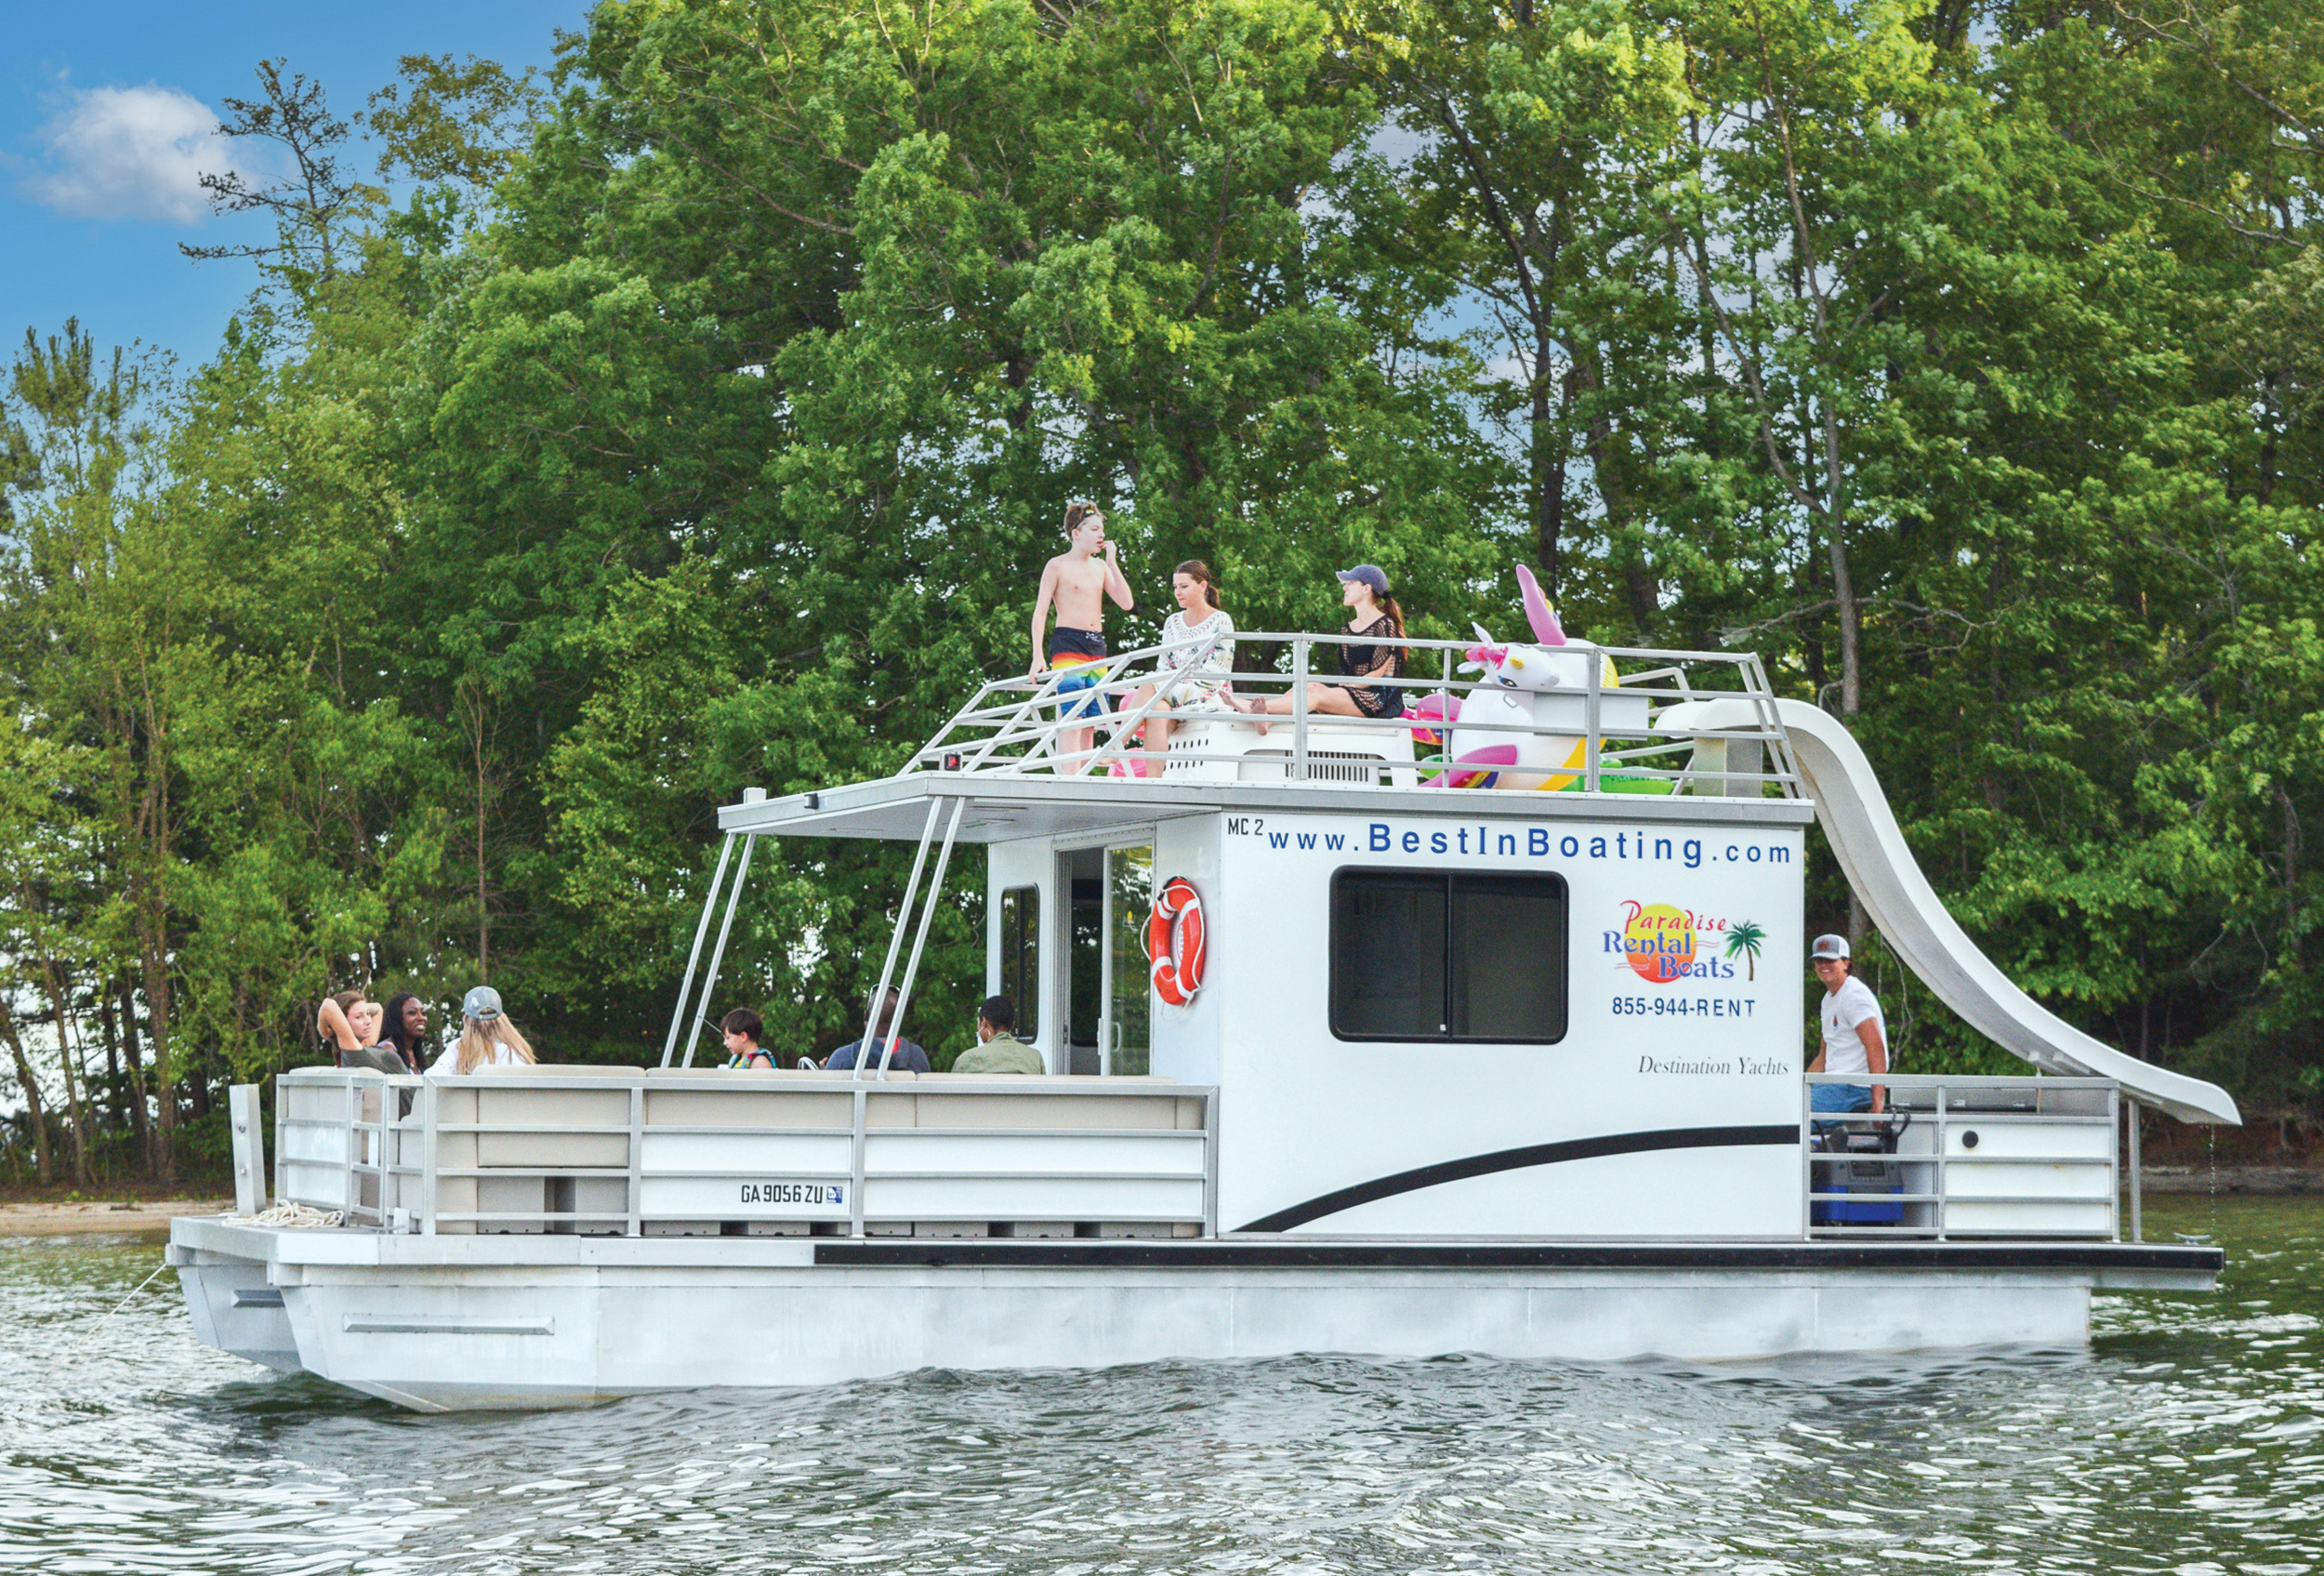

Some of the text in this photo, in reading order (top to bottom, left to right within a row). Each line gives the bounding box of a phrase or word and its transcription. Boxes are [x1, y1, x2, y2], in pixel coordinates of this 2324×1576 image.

[1227, 817, 1264, 836] MC 2
[1268, 823, 1789, 868] www.BestInBoating.com
[1619, 899, 1726, 934] Paradise
[1603, 930, 1691, 956] Rental
[1658, 955, 1735, 979] Boats
[1612, 996, 1755, 1017] 855-944-RENT
[1637, 1054, 1789, 1075] Destination Yachts
